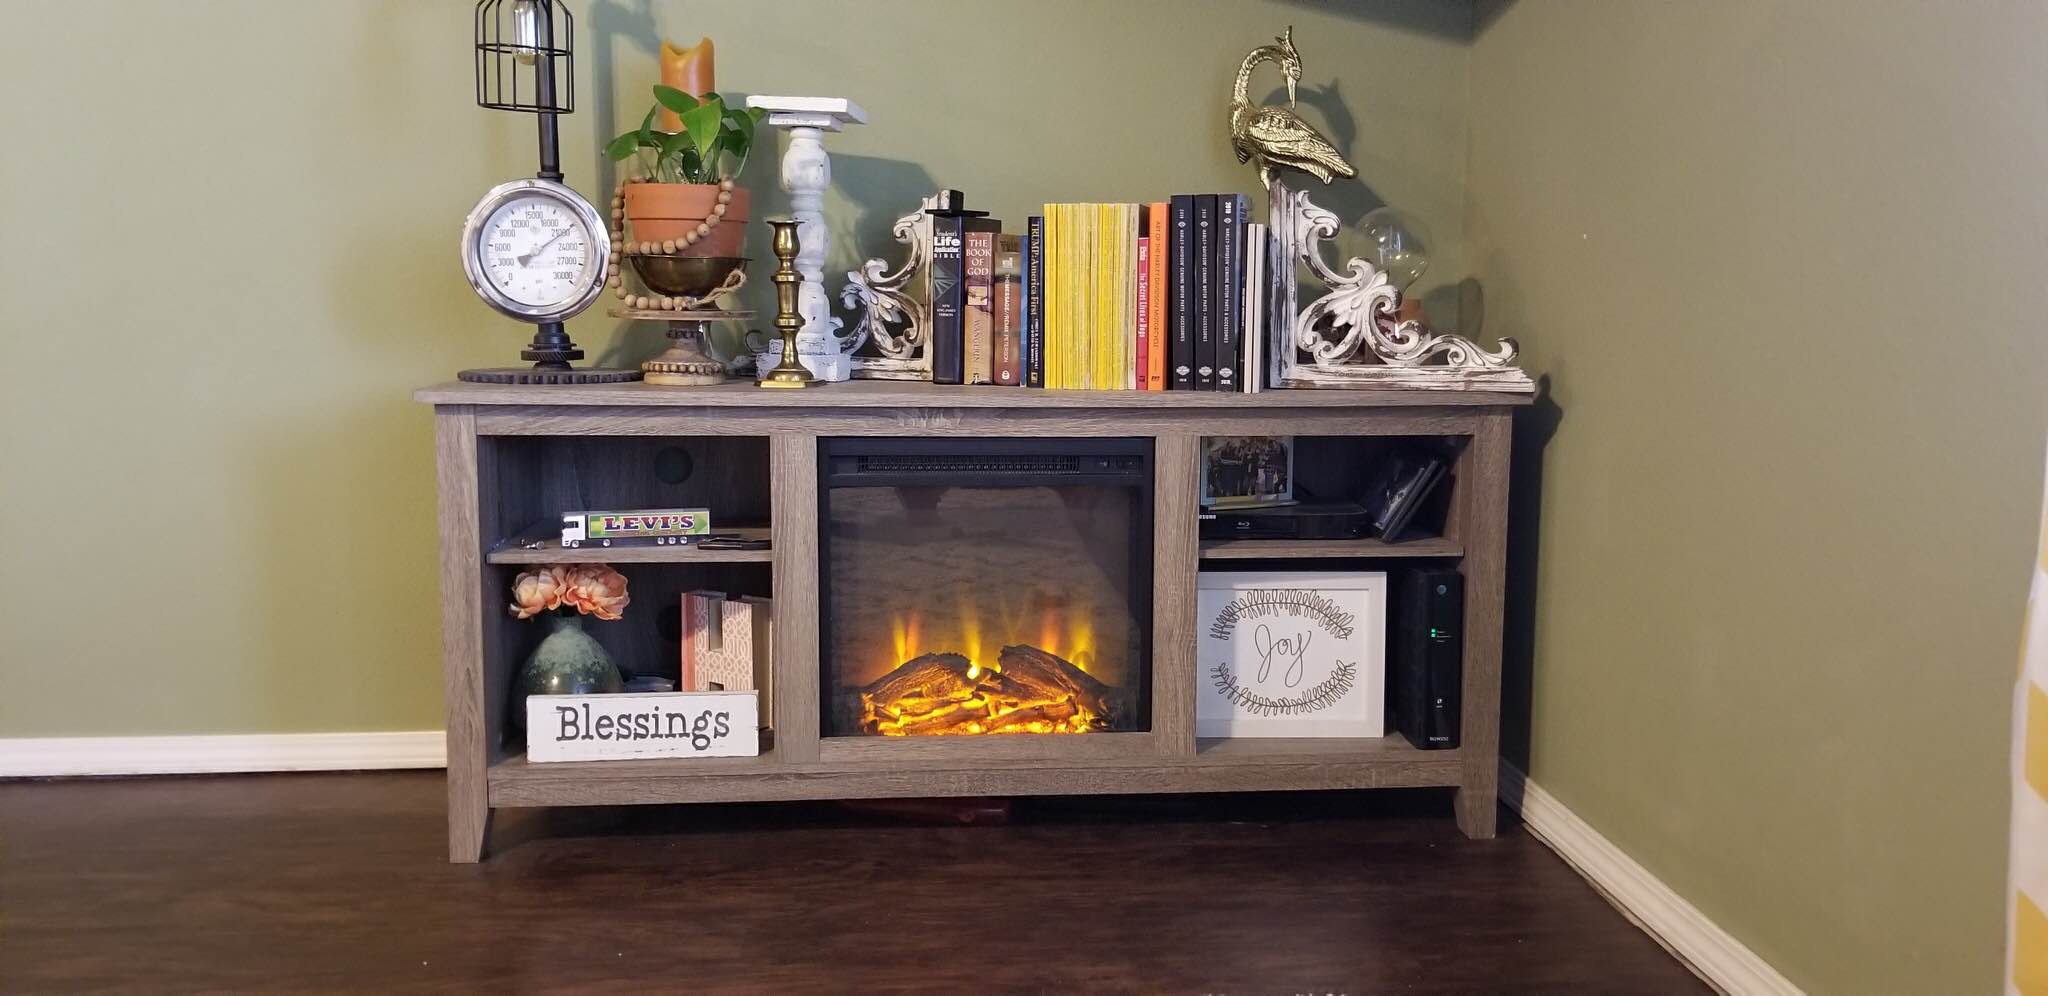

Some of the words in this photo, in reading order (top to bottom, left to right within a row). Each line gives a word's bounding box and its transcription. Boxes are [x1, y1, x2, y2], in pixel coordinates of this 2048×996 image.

[525, 211, 544, 219] 15000
[511, 220, 530, 228] 12000
[541, 218, 559, 227] 18000
[499, 228, 516, 237] 9000
[1155, 232, 1160, 242] OF
[934, 236, 960, 246] Life
[968, 240, 988, 248] THE
[494, 243, 511, 252] 6000
[558, 242, 578, 251] 24000
[498, 258, 514, 266] 3000
[557, 256, 577, 265] 27000
[972, 258, 984, 266] OF
[553, 271, 573, 280] 30000
[968, 268, 988, 276] GOD
[1031, 258, 1040, 295] America
[1030, 296, 1039, 316] First
[604, 514, 694, 532] LEVI'S
[1254, 624, 1312, 688] Joy
[556, 703, 730, 750] Blessings
